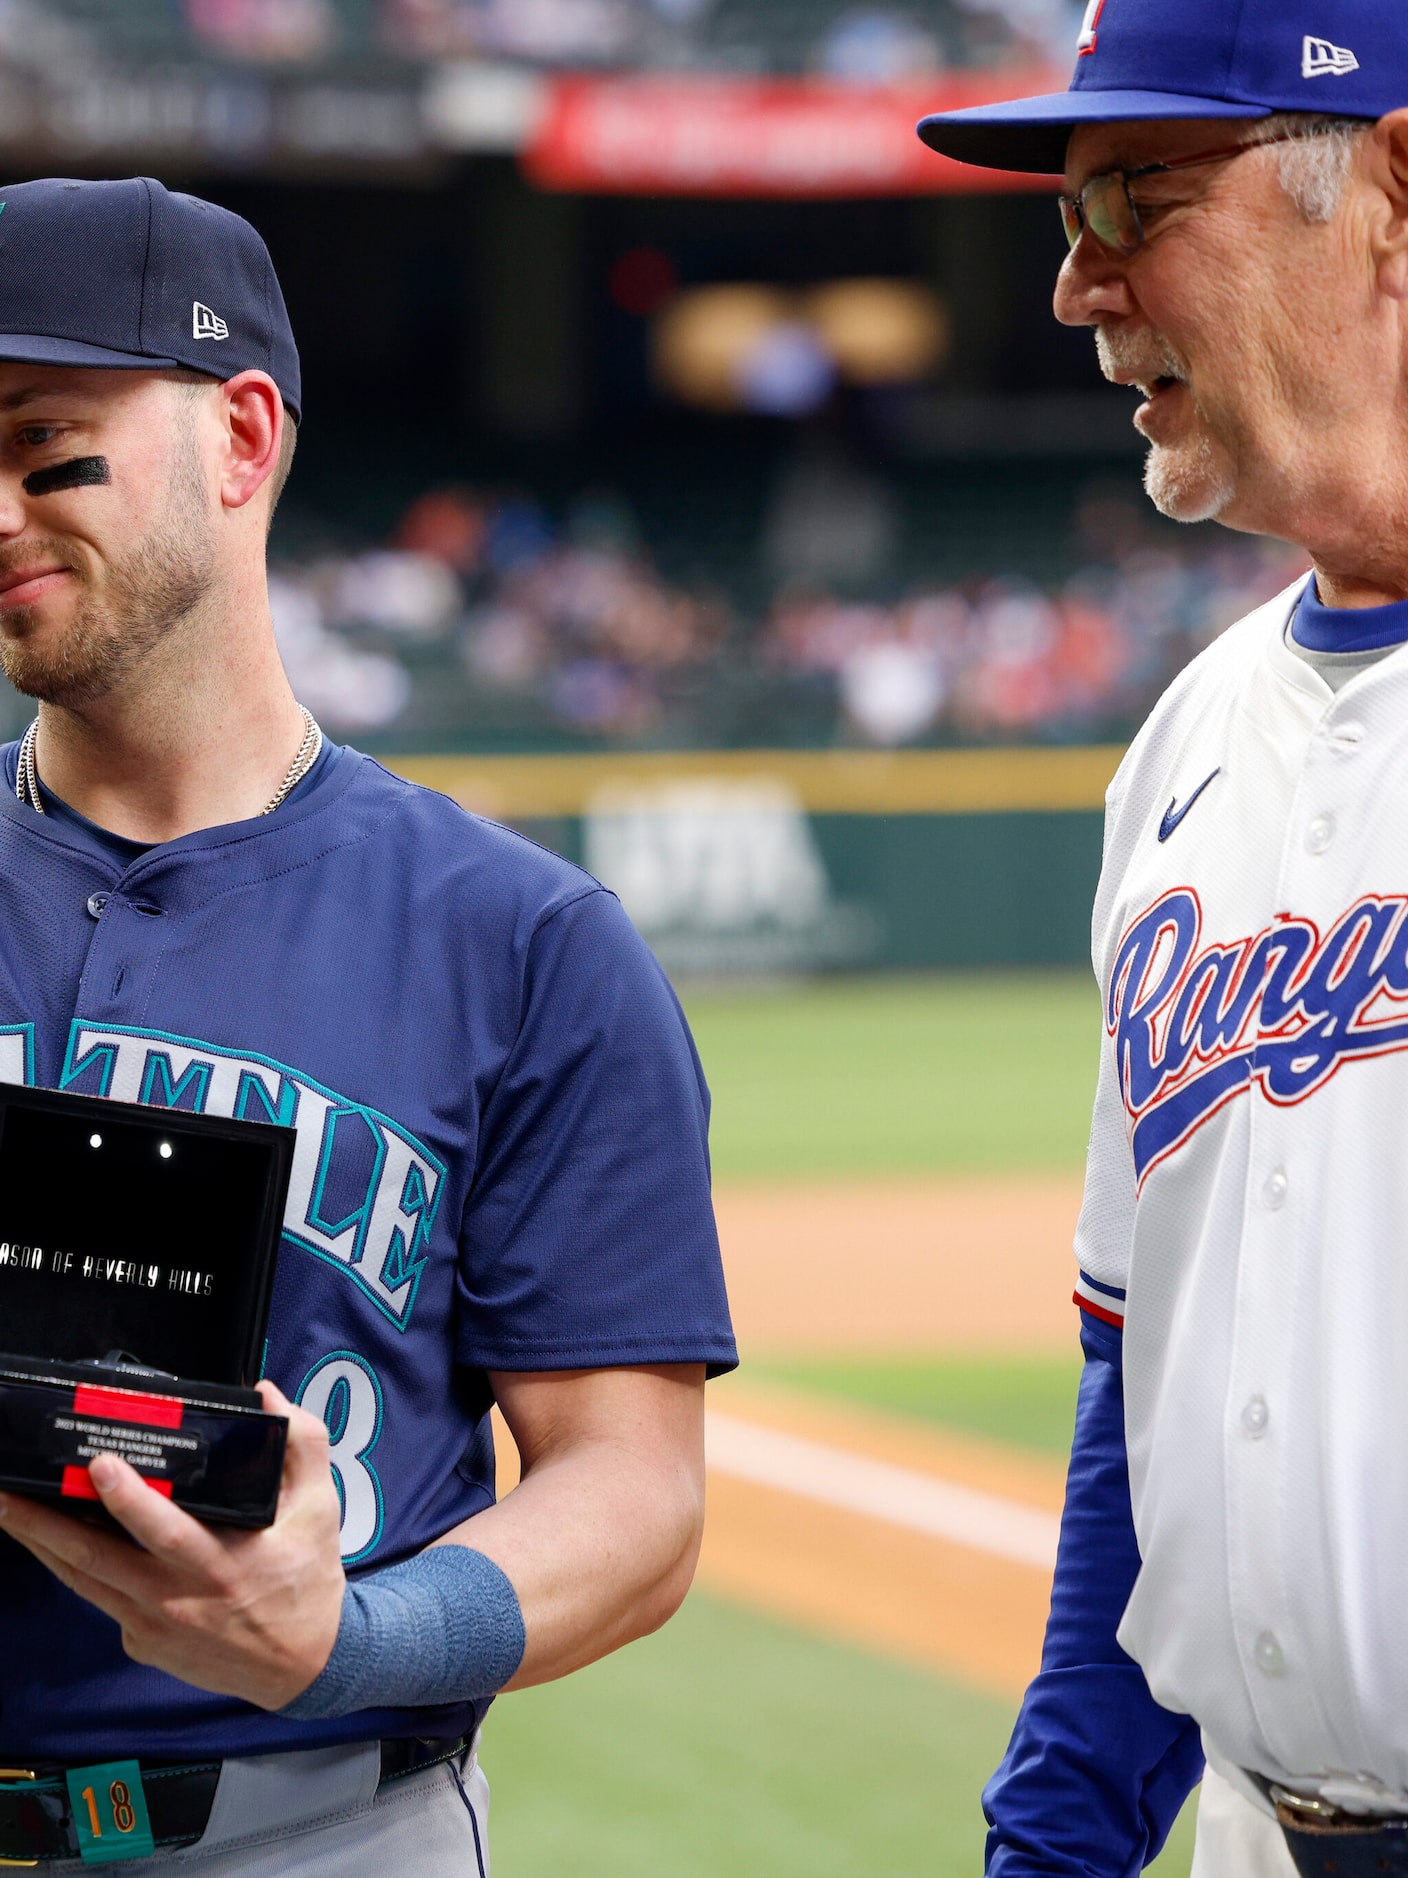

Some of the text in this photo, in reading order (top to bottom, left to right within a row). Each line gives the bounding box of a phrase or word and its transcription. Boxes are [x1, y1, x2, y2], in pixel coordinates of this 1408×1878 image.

[52, 1250, 74, 1274] OF
[168, 1268, 214, 1296] HILLS
[75, 1421, 110, 1436] WORLD
[110, 1427, 142, 1441] SERIES
[142, 1432, 198, 1450] CHAMPIONS
[87, 1435, 162, 1456] TEXAS RANGERS
[126, 1453, 167, 1469] GARVER
[81, 1780, 135, 1838] 18
